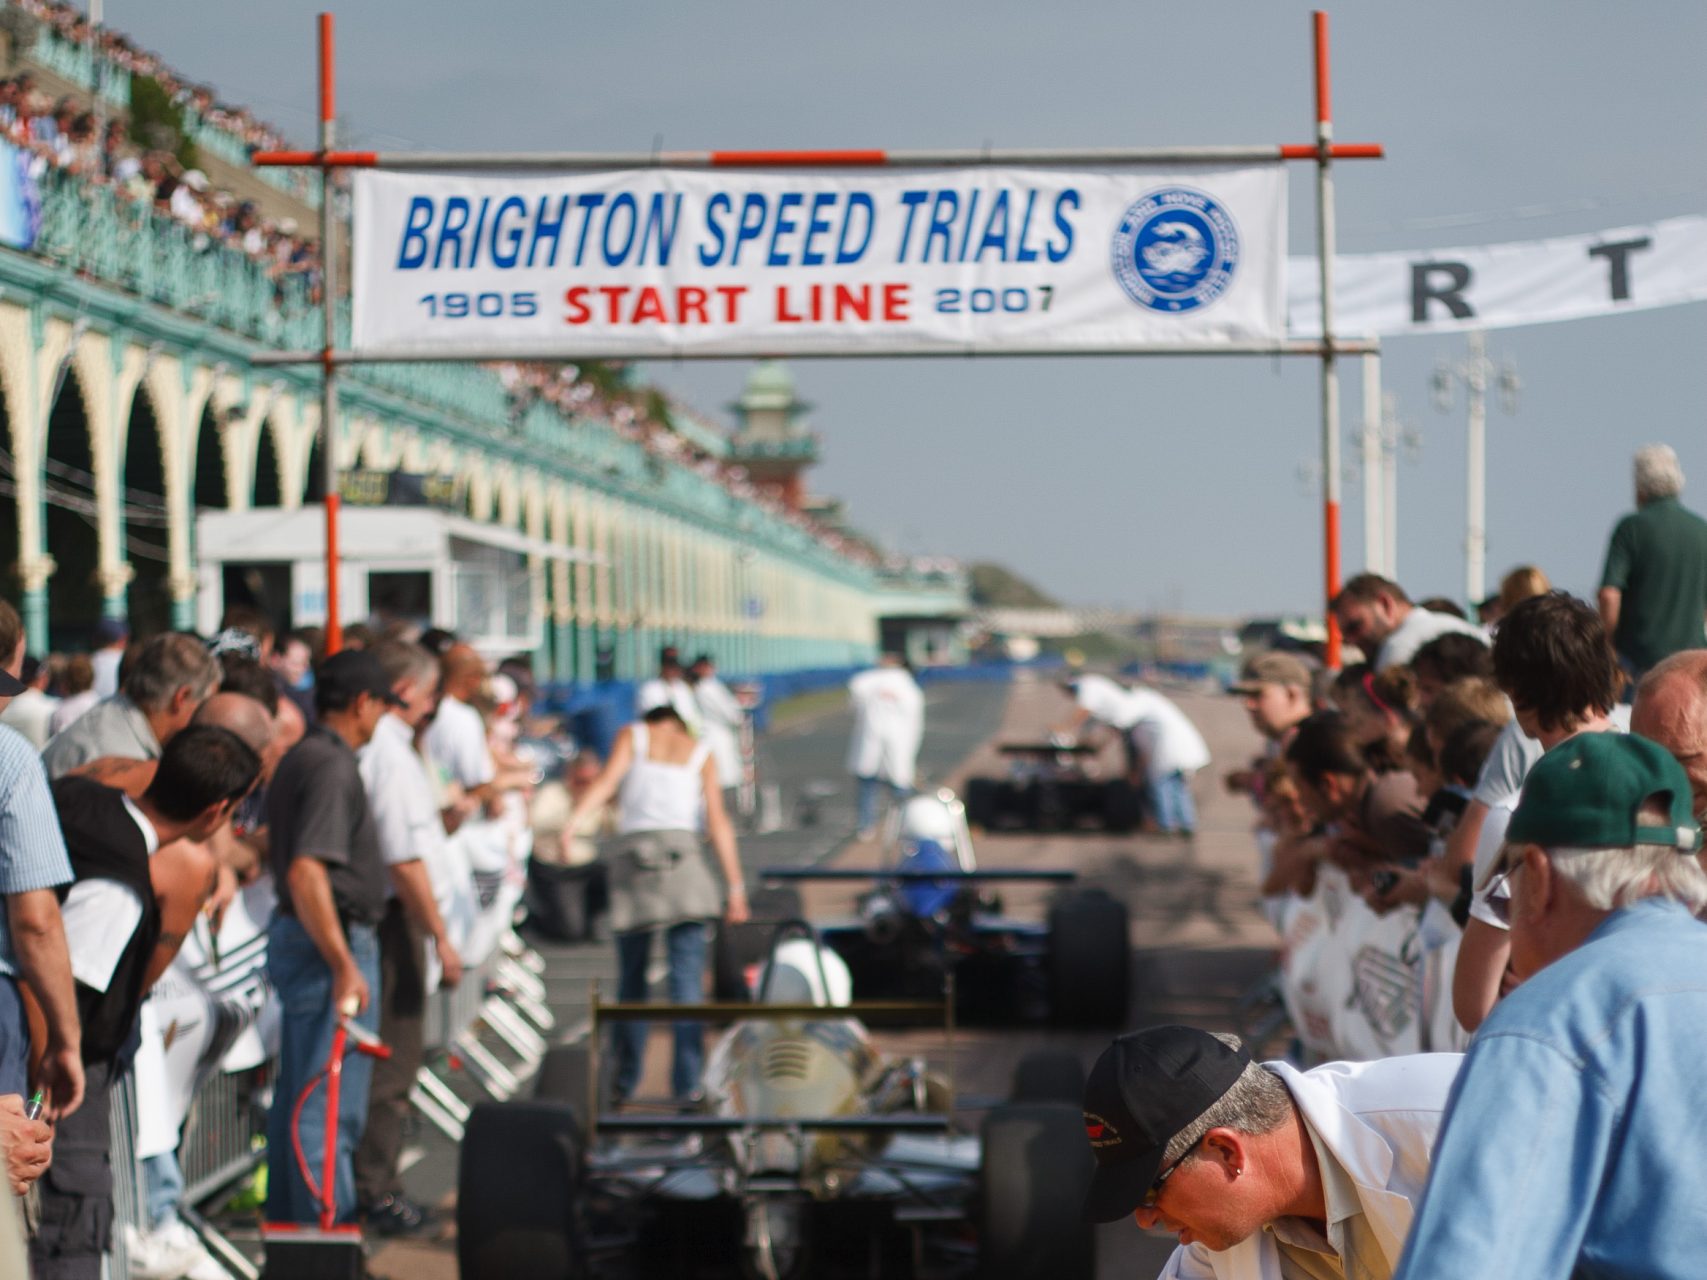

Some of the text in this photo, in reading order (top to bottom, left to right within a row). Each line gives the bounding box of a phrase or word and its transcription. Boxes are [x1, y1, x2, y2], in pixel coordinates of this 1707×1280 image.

[397, 187, 1083, 270] BRIGHTON SPEED TRIALS
[419, 283, 1053, 325] 1905 START LINE 2007
